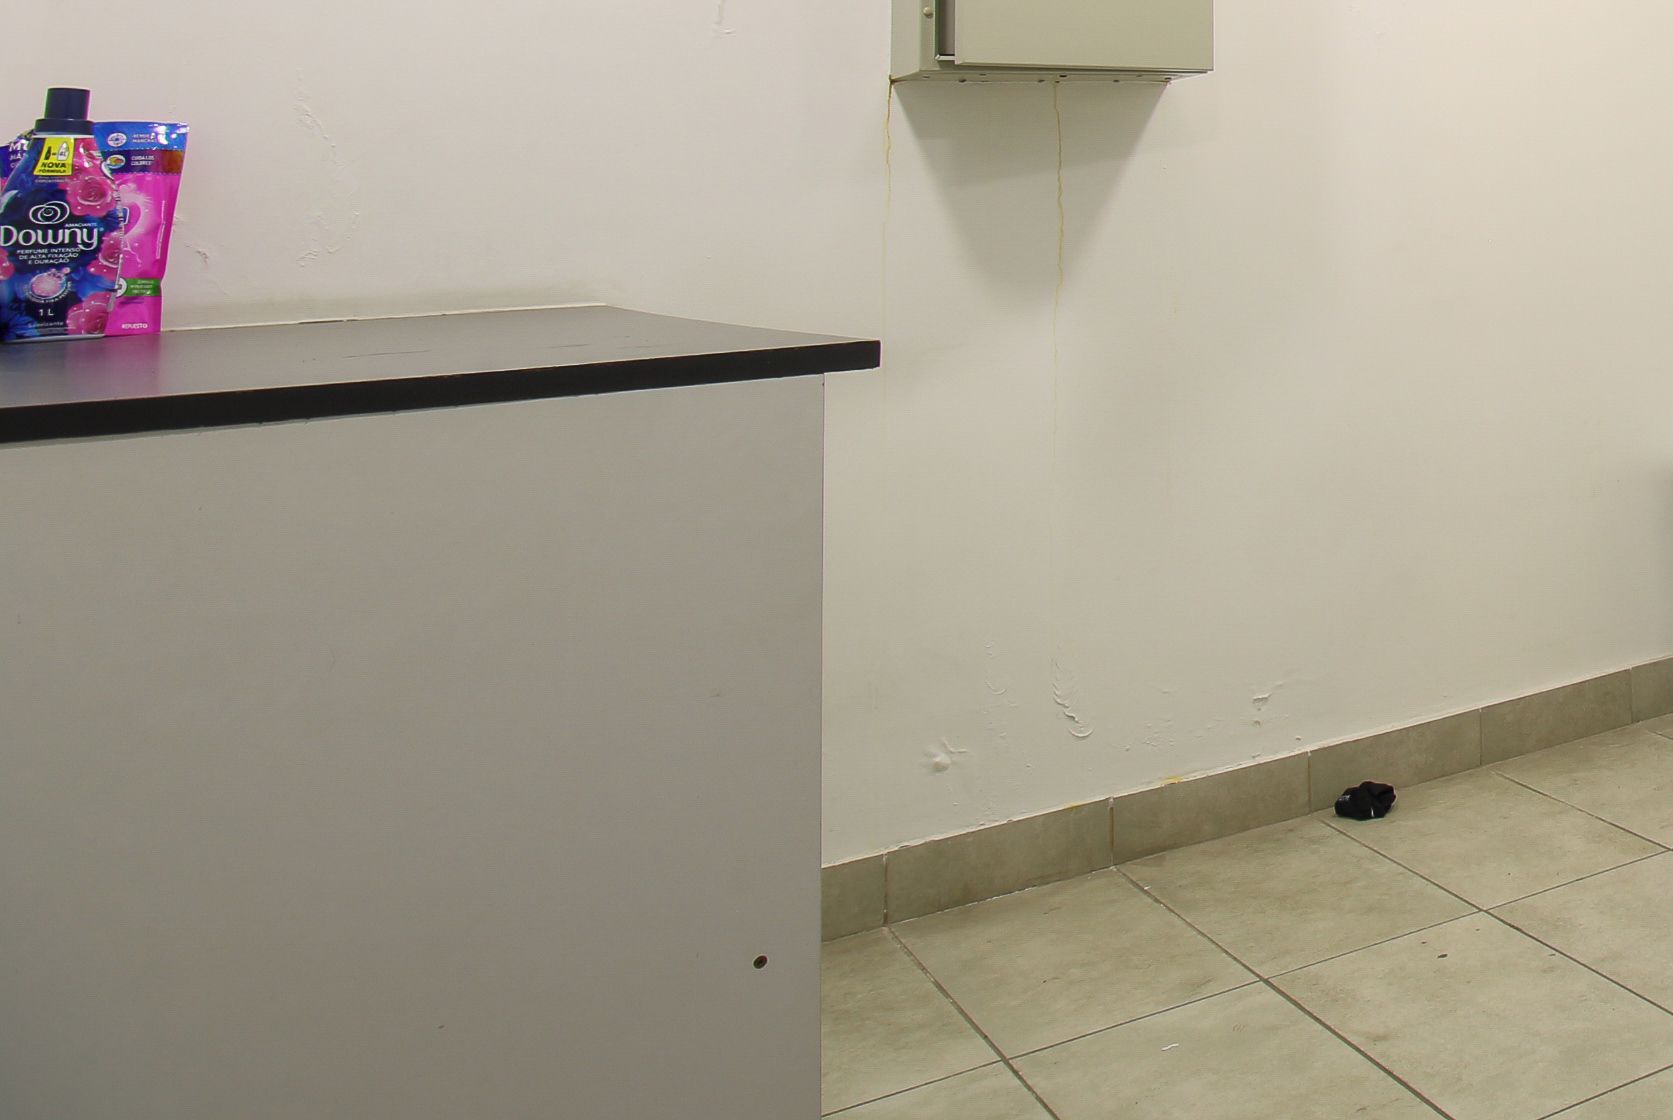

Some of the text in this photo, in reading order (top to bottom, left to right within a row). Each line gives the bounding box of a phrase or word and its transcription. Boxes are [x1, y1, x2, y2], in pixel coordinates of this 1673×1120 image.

[41, 161, 67, 169] NOVA
[0, 225, 98, 251] Downy
[47, 308, 54, 316] L
